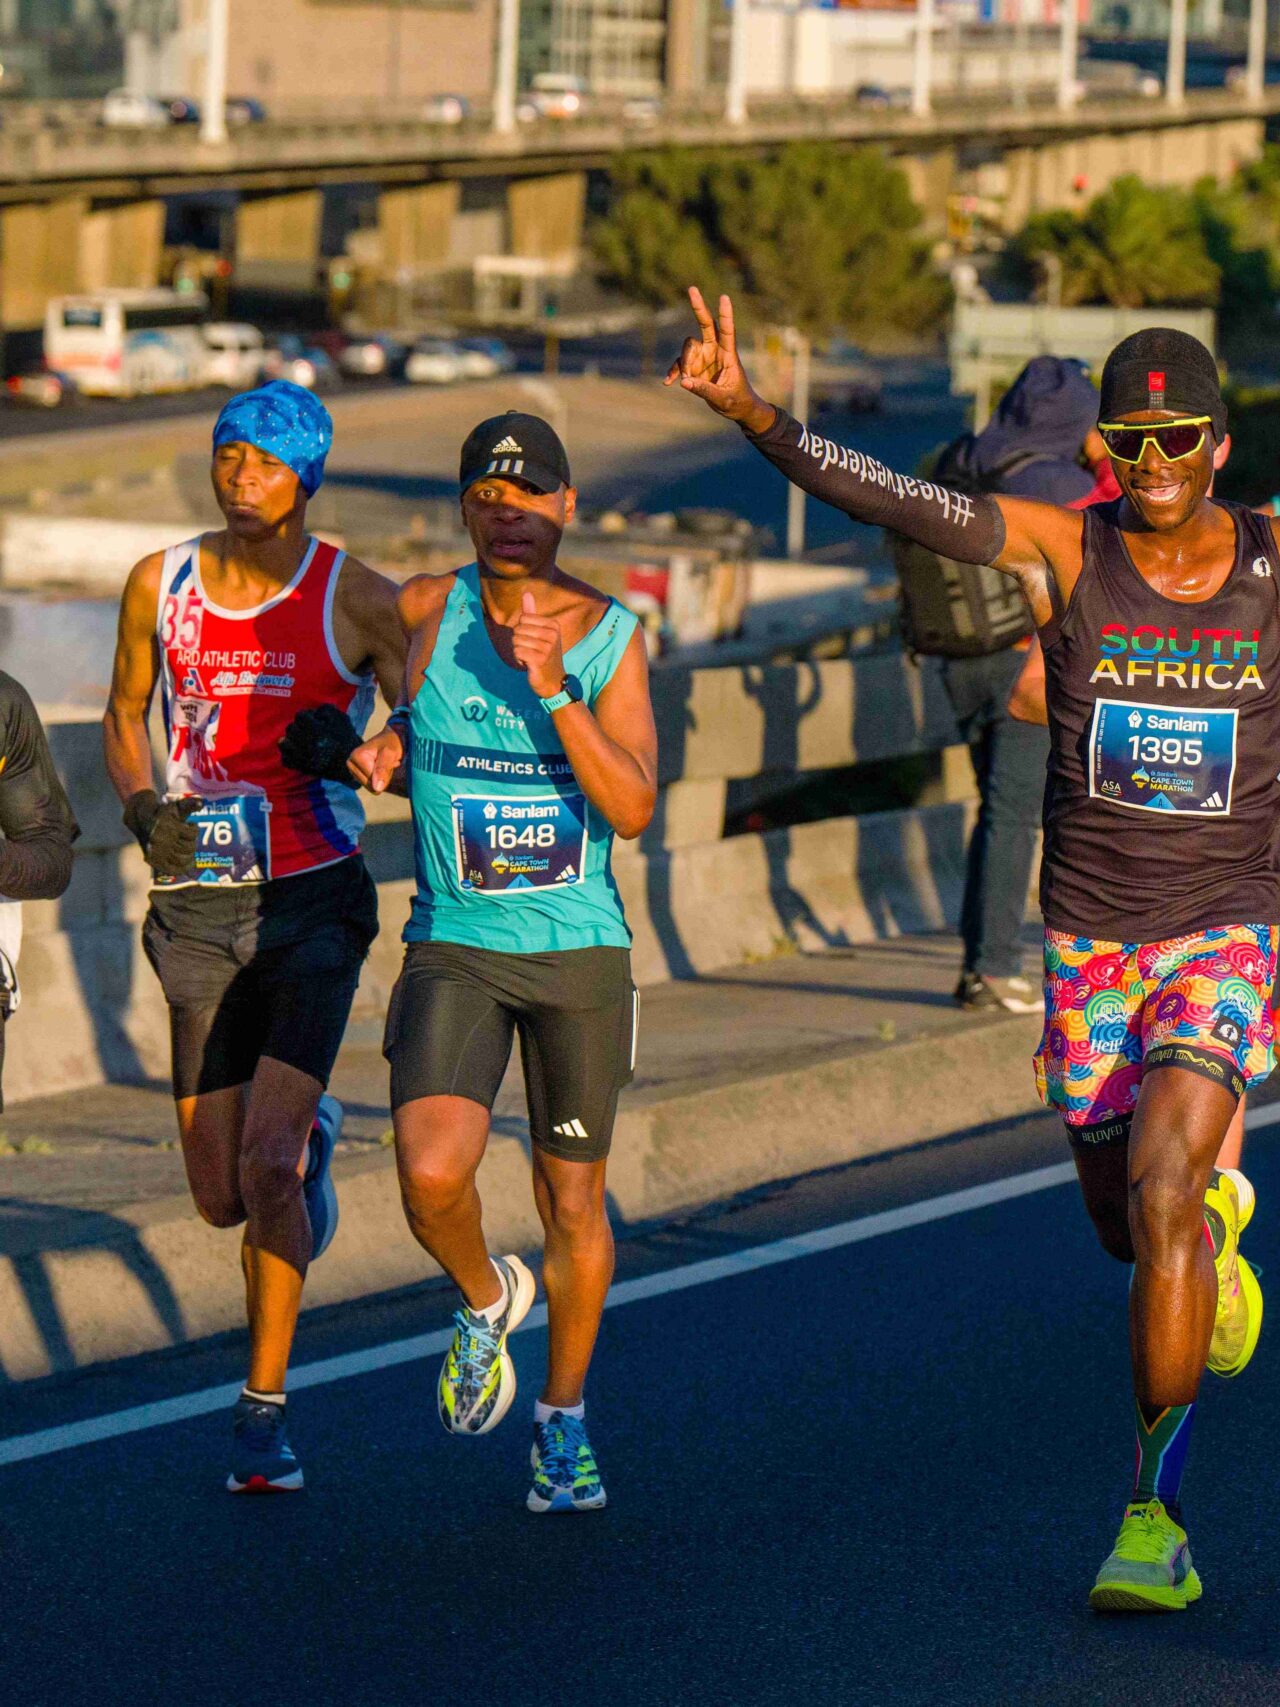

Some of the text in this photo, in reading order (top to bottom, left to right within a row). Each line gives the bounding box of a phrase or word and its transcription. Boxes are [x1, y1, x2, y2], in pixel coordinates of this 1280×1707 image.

[797, 423, 976, 527] #beatyesterday
[1099, 622, 1261, 660] SOUTH
[201, 650, 261, 668] ATHLETIC
[263, 651, 296, 669] CLUB
[1088, 654, 1266, 690] AFRICA
[495, 717, 526, 731] CITY
[1146, 714, 1209, 733] Sanlam
[1128, 735, 1202, 766] 1395
[456, 756, 534, 775] ATHLETICS
[1102, 779, 1121, 792] ASA
[1150, 776, 1194, 786] CAPE TOWN
[1150, 783, 1194, 793] MARATHON
[501, 804, 559, 819] Sanlam
[485, 823, 556, 849] 1648
[509, 858, 549, 867] CAPE TOWN
[509, 863, 549, 874] MARATHON
[1081, 1124, 1123, 1144] BELOVED
